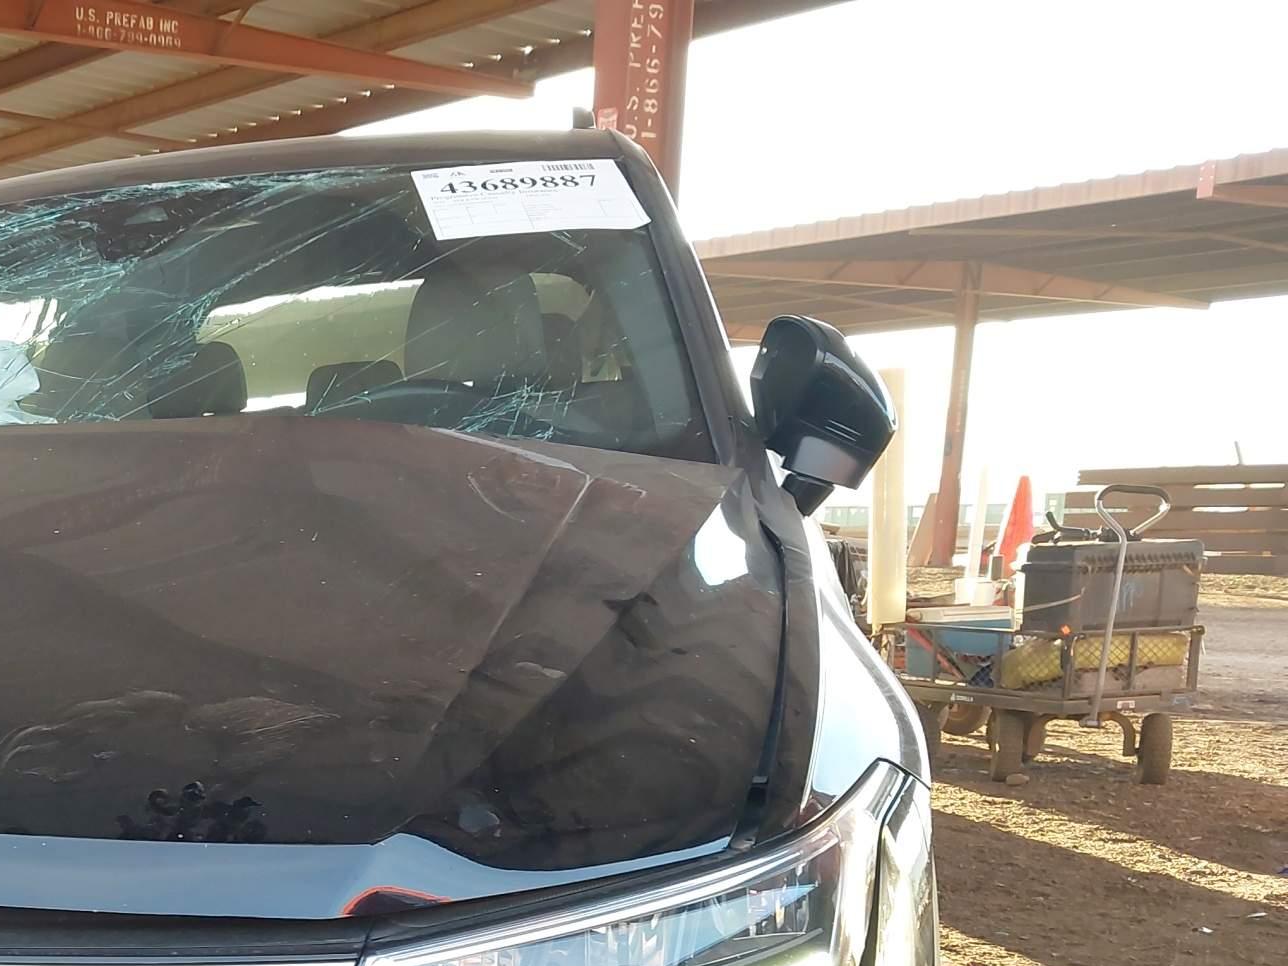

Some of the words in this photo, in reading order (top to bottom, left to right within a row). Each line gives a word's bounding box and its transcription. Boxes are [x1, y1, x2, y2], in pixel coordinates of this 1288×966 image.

[75, 7, 100, 23] U.S.
[105, 11, 154, 31] PREFAB
[440, 174, 596, 194] 43689887
